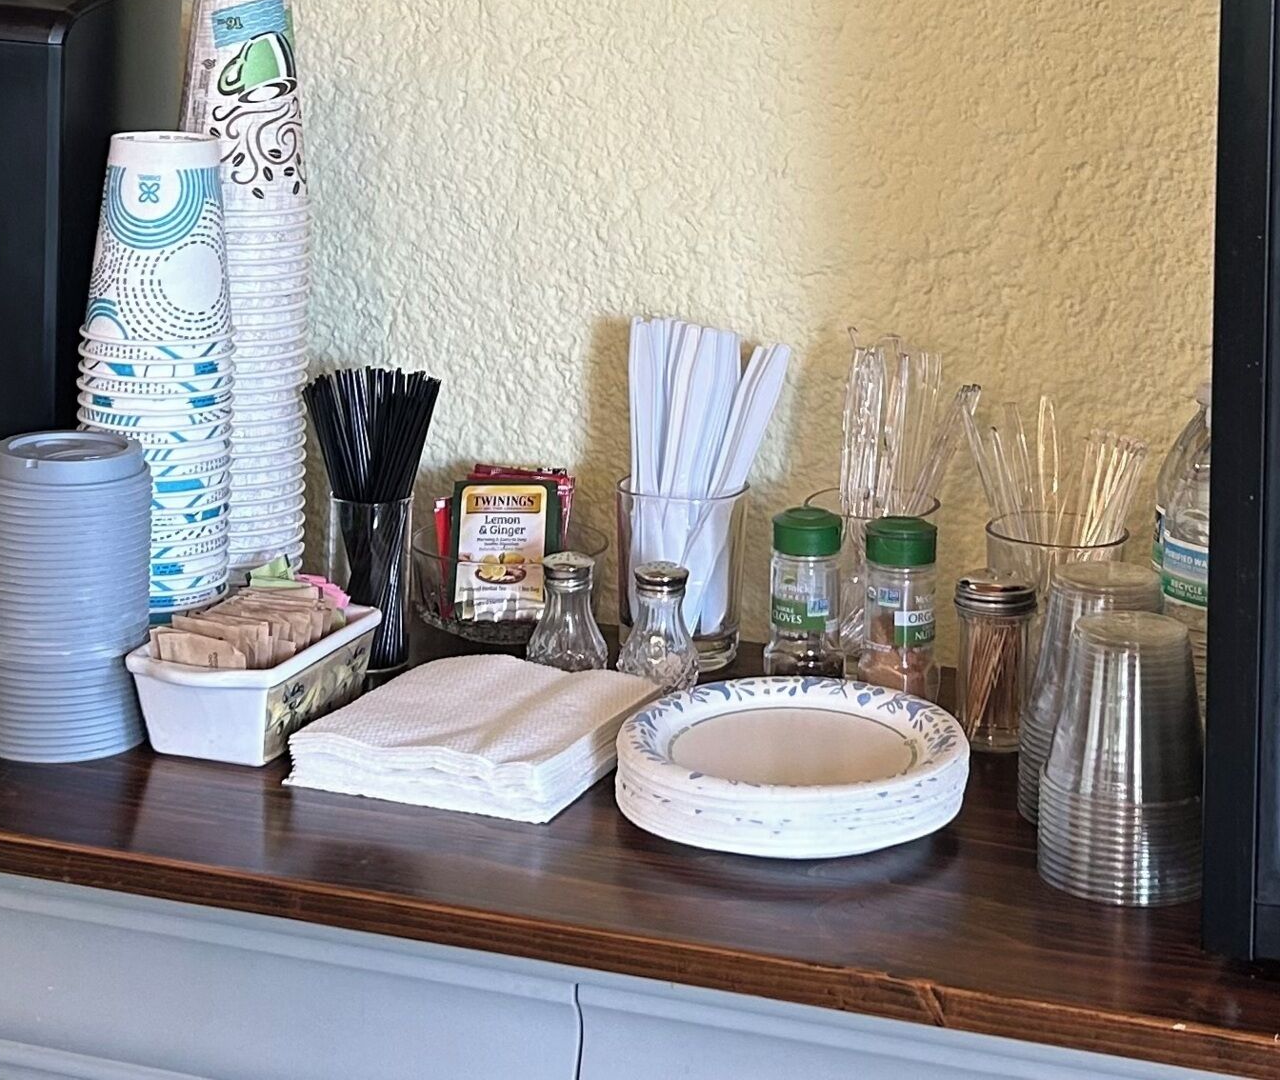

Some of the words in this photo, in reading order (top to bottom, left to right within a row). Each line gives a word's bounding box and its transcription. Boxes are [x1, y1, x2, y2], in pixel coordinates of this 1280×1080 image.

[474, 495, 535, 507] TWININGS
[485, 515, 521, 525] Lemon
[479, 525, 487, 535] &
[489, 525, 526, 537] Ginger
[1171, 579, 1202, 595] RECYCLE
[773, 609, 802, 624] CLOVES
